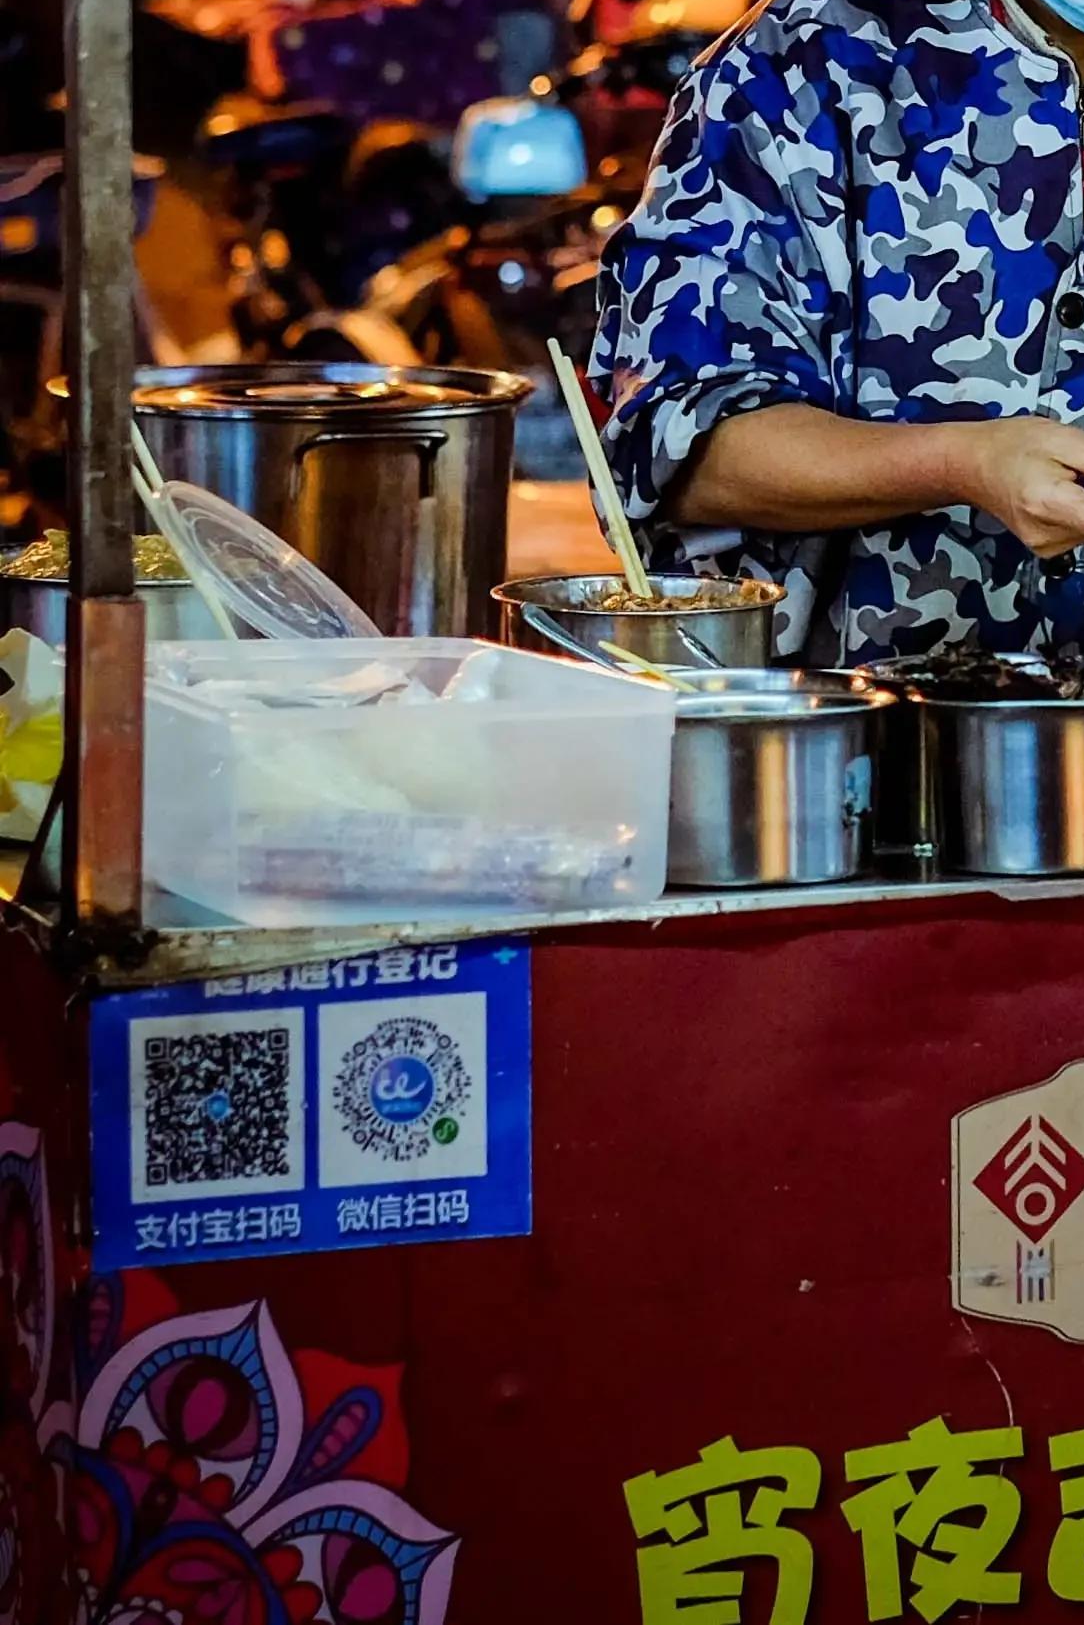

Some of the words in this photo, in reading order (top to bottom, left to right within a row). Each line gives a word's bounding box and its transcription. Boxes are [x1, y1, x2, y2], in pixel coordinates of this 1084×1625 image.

[134, 1202, 300, 1251] 支付宝扫码
[337, 1189, 470, 1234] 微信扫码
